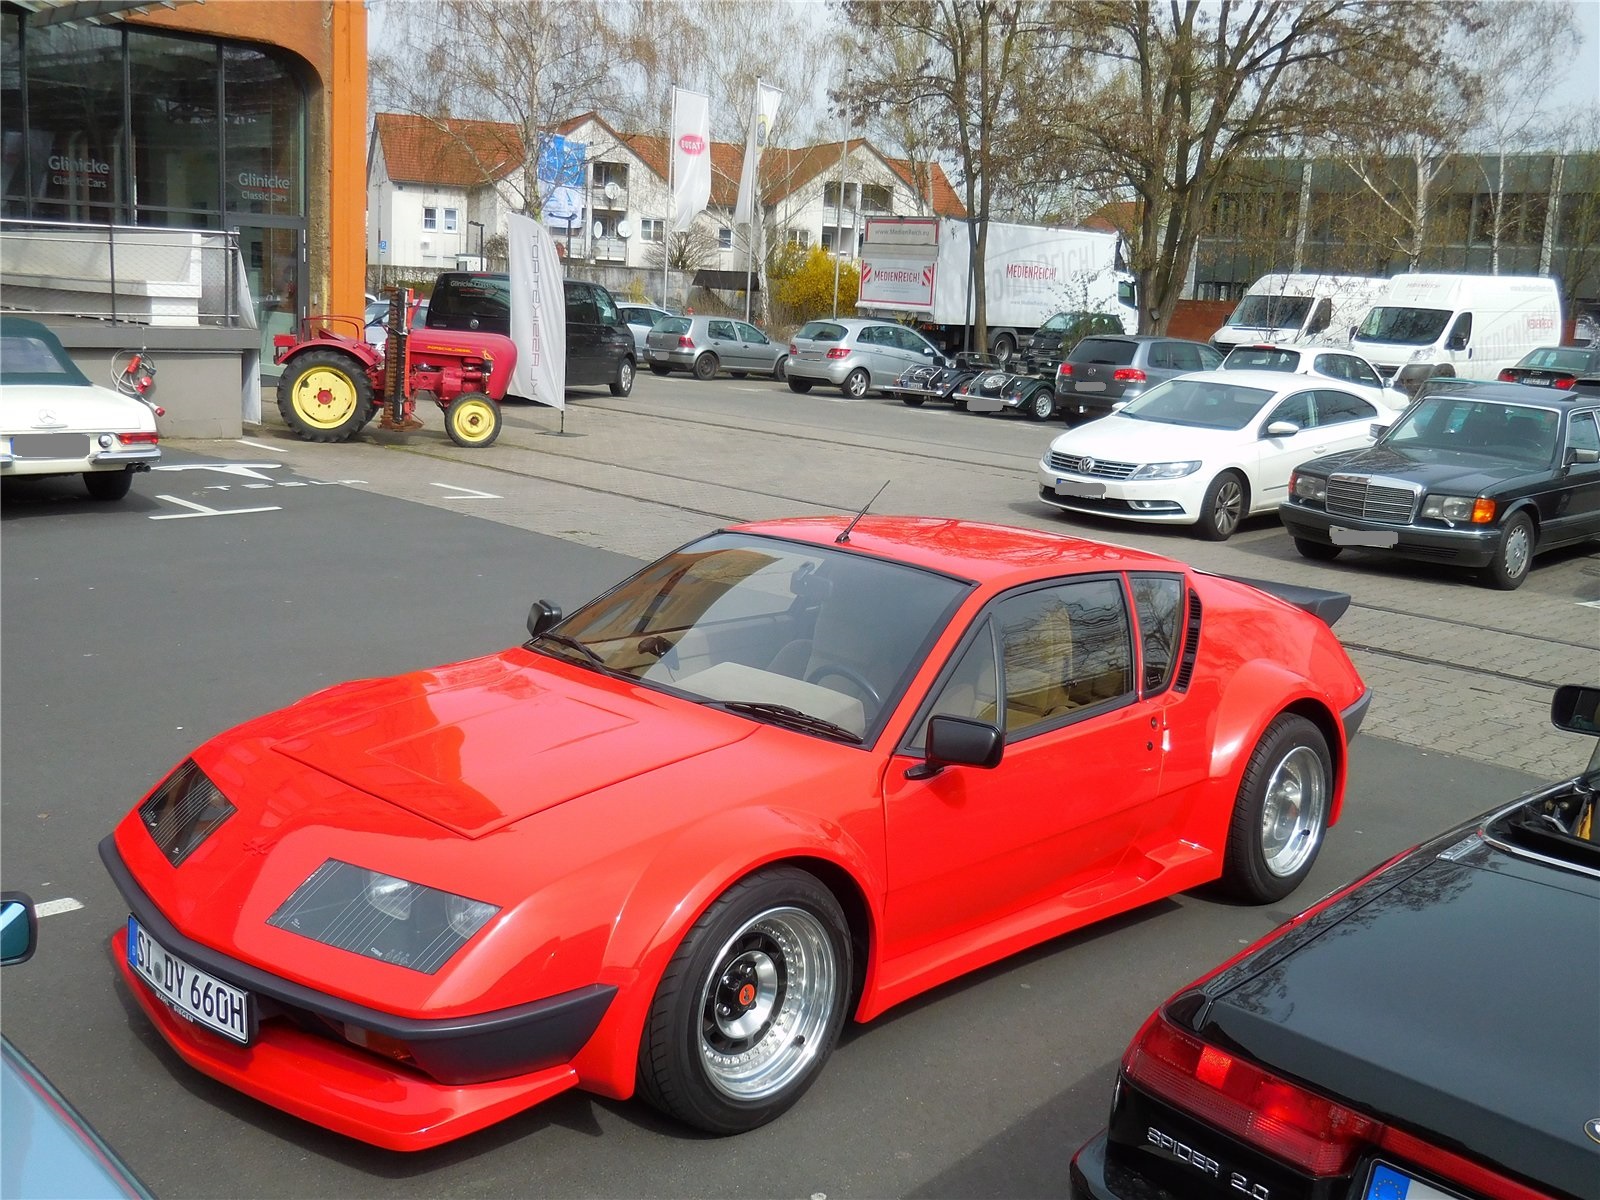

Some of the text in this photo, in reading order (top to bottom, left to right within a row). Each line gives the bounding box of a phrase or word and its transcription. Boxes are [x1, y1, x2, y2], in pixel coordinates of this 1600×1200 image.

[48, 155, 110, 174] Glinicke
[238, 172, 290, 189] Glinicke
[241, 190, 270, 201] Classic
[138, 930, 246, 1034] SI DY 660H
[1146, 1126, 1269, 1200] SPIDER 2.0
